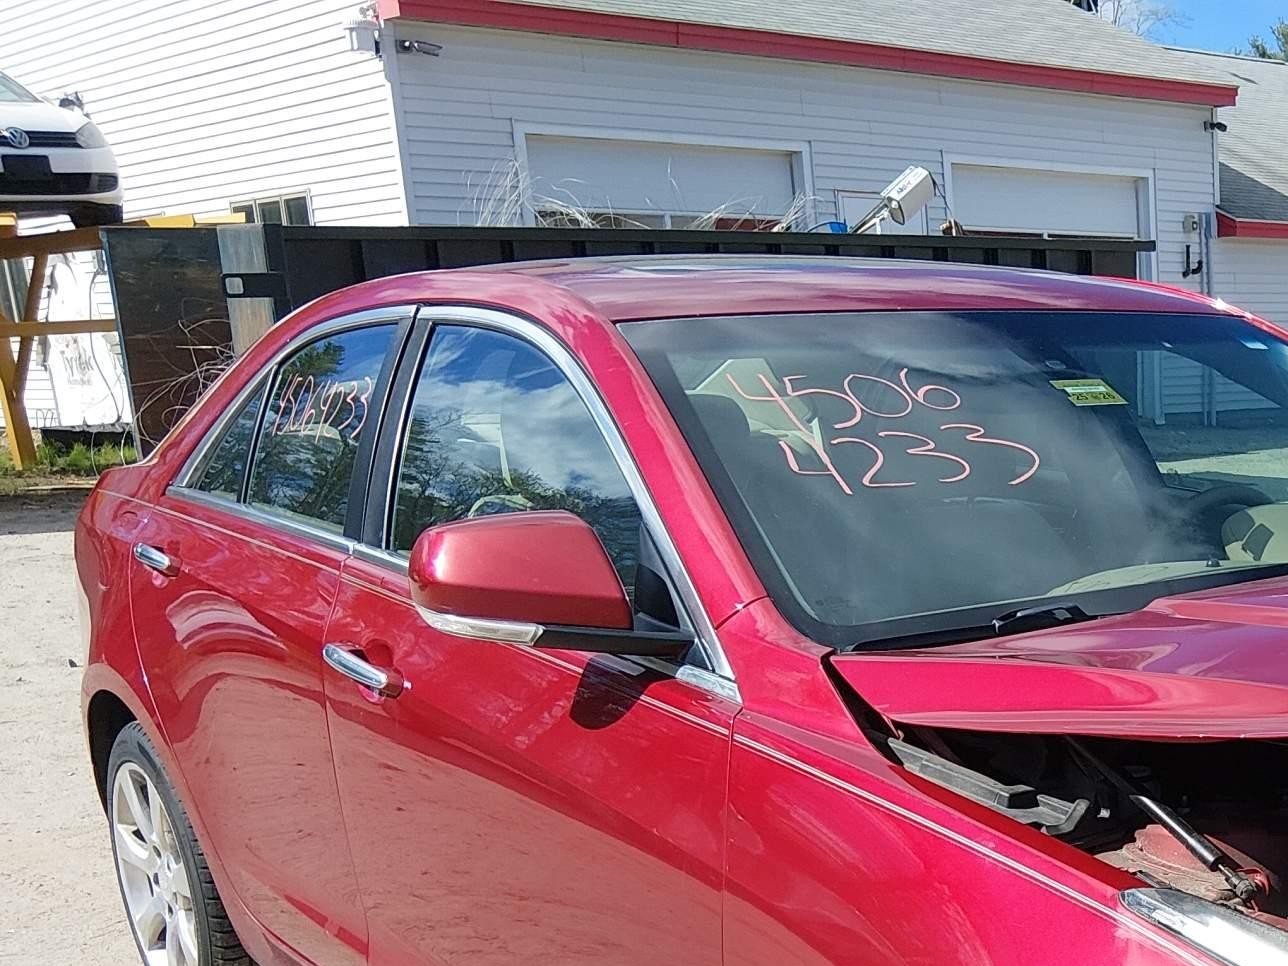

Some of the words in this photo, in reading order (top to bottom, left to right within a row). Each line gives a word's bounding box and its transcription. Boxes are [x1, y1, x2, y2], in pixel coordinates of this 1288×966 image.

[272, 373, 372, 444] 45064233
[726, 367, 961, 436] 4506
[778, 423, 1040, 496] 4233
